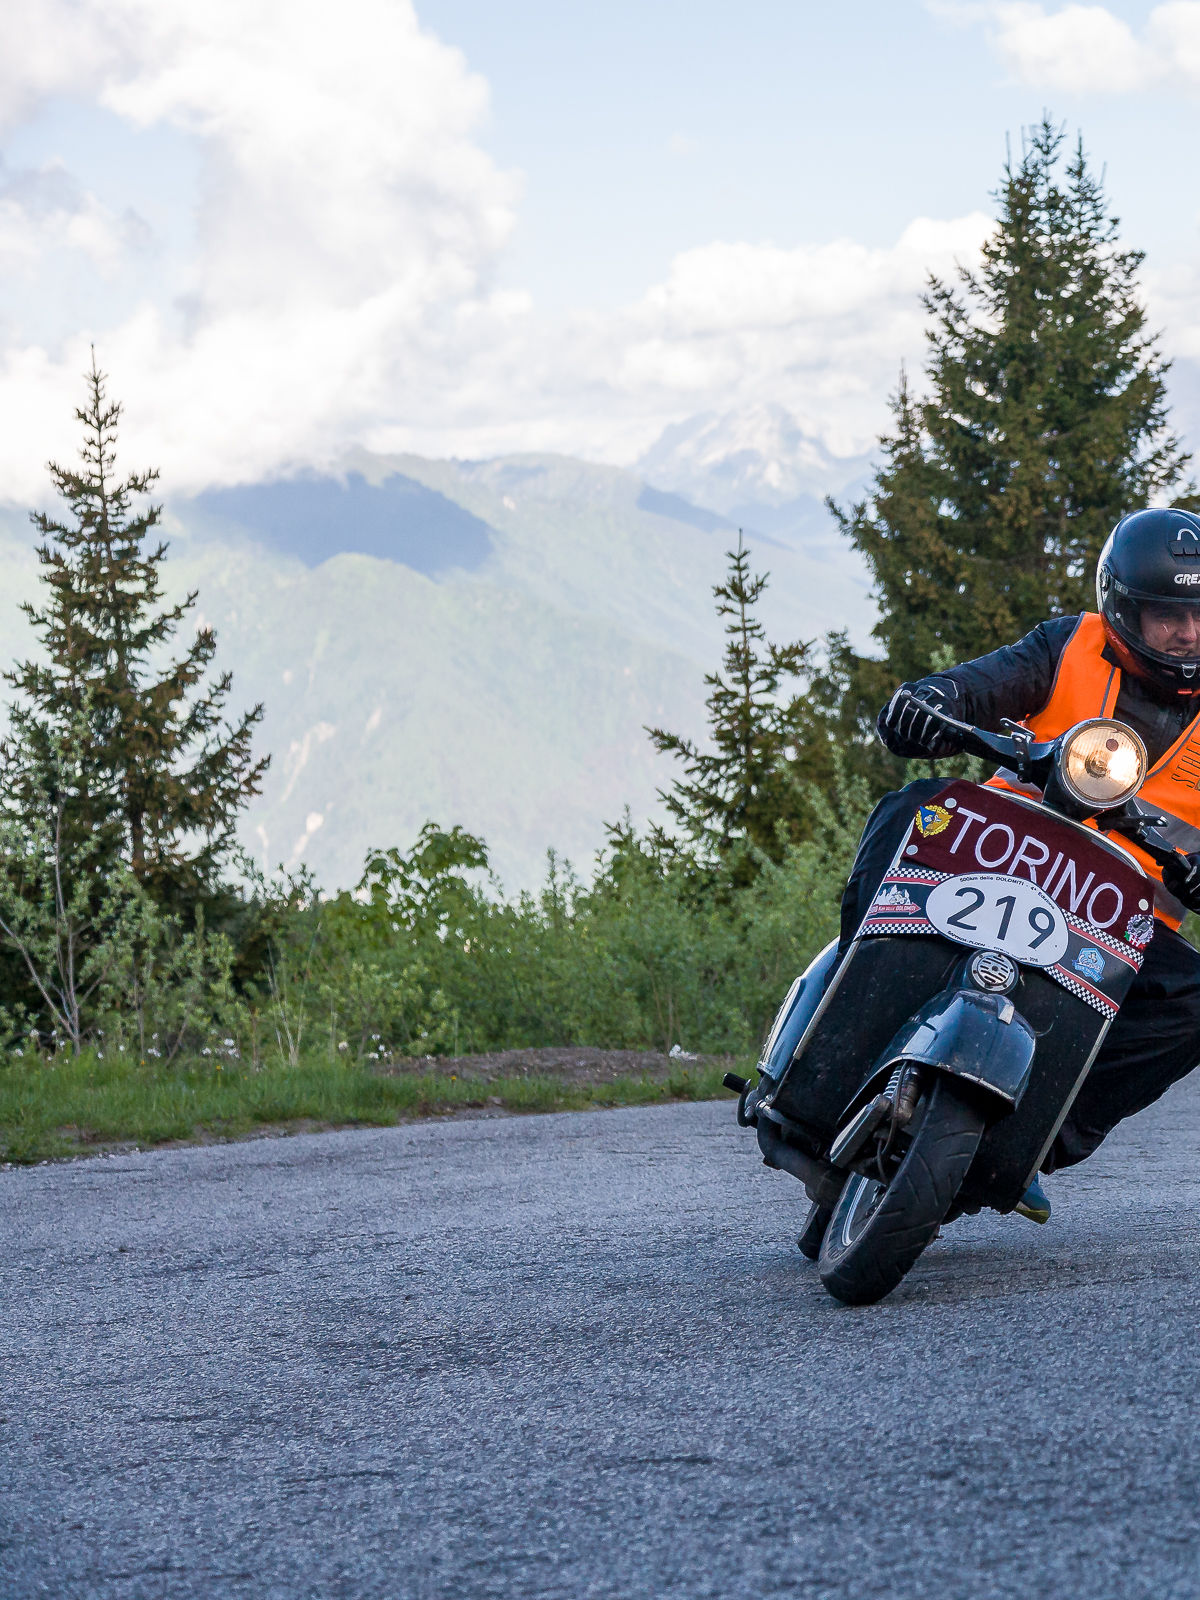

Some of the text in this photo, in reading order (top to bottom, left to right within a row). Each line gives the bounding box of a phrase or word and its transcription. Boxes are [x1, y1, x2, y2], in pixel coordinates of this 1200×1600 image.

[949, 806, 1124, 929] TORINO
[995, 876, 1025, 887] DOLOMITI
[946, 886, 1057, 951] 219
